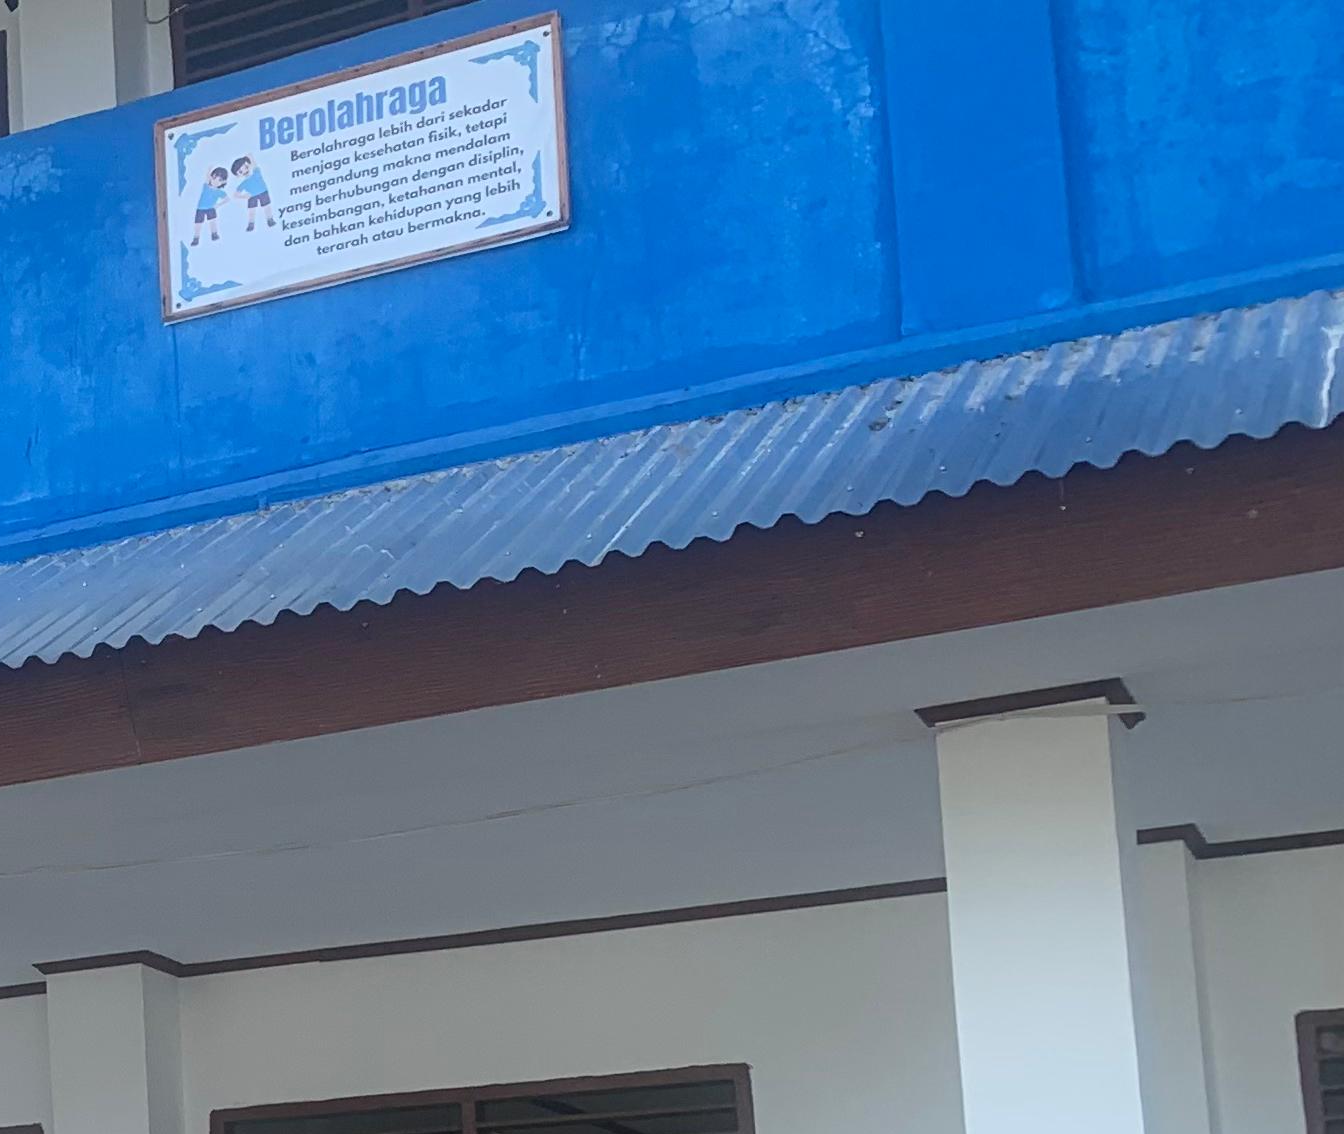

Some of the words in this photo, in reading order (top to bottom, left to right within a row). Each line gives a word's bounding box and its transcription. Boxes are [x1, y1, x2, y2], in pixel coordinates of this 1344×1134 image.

[259, 76, 447, 151] Berolahraga
[290, 133, 375, 162] Berolahraga
[379, 120, 413, 139] lebih
[416, 111, 445, 129] dari
[449, 99, 508, 120] sekadar
[291, 157, 350, 178] menjaga
[354, 137, 425, 162] kesehatan
[428, 126, 462, 143] fisik,
[465, 112, 507, 134] tetapi
[278, 200, 312, 219] yang
[315, 176, 408, 206] berhubungan
[412, 161, 465, 182] dengan
[468, 146, 524, 167] disiplin,
[282, 200, 385, 231] keseimbangan,
[388, 179, 463, 204] ketahanan
[467, 160, 522, 184] mental,
[290, 166, 379, 196] mengandung
[383, 153, 431, 172] makna
[435, 132, 510, 159] mendalam
[284, 234, 310, 247] dan
[313, 221, 365, 240] bahkan
[368, 201, 442, 226] kehidupan
[445, 192, 481, 210] yang
[485, 178, 520, 197] lebih
[316, 233, 368, 255] terarah
[372, 227, 404, 242] atau
[407, 209, 486, 233] bermakna.
